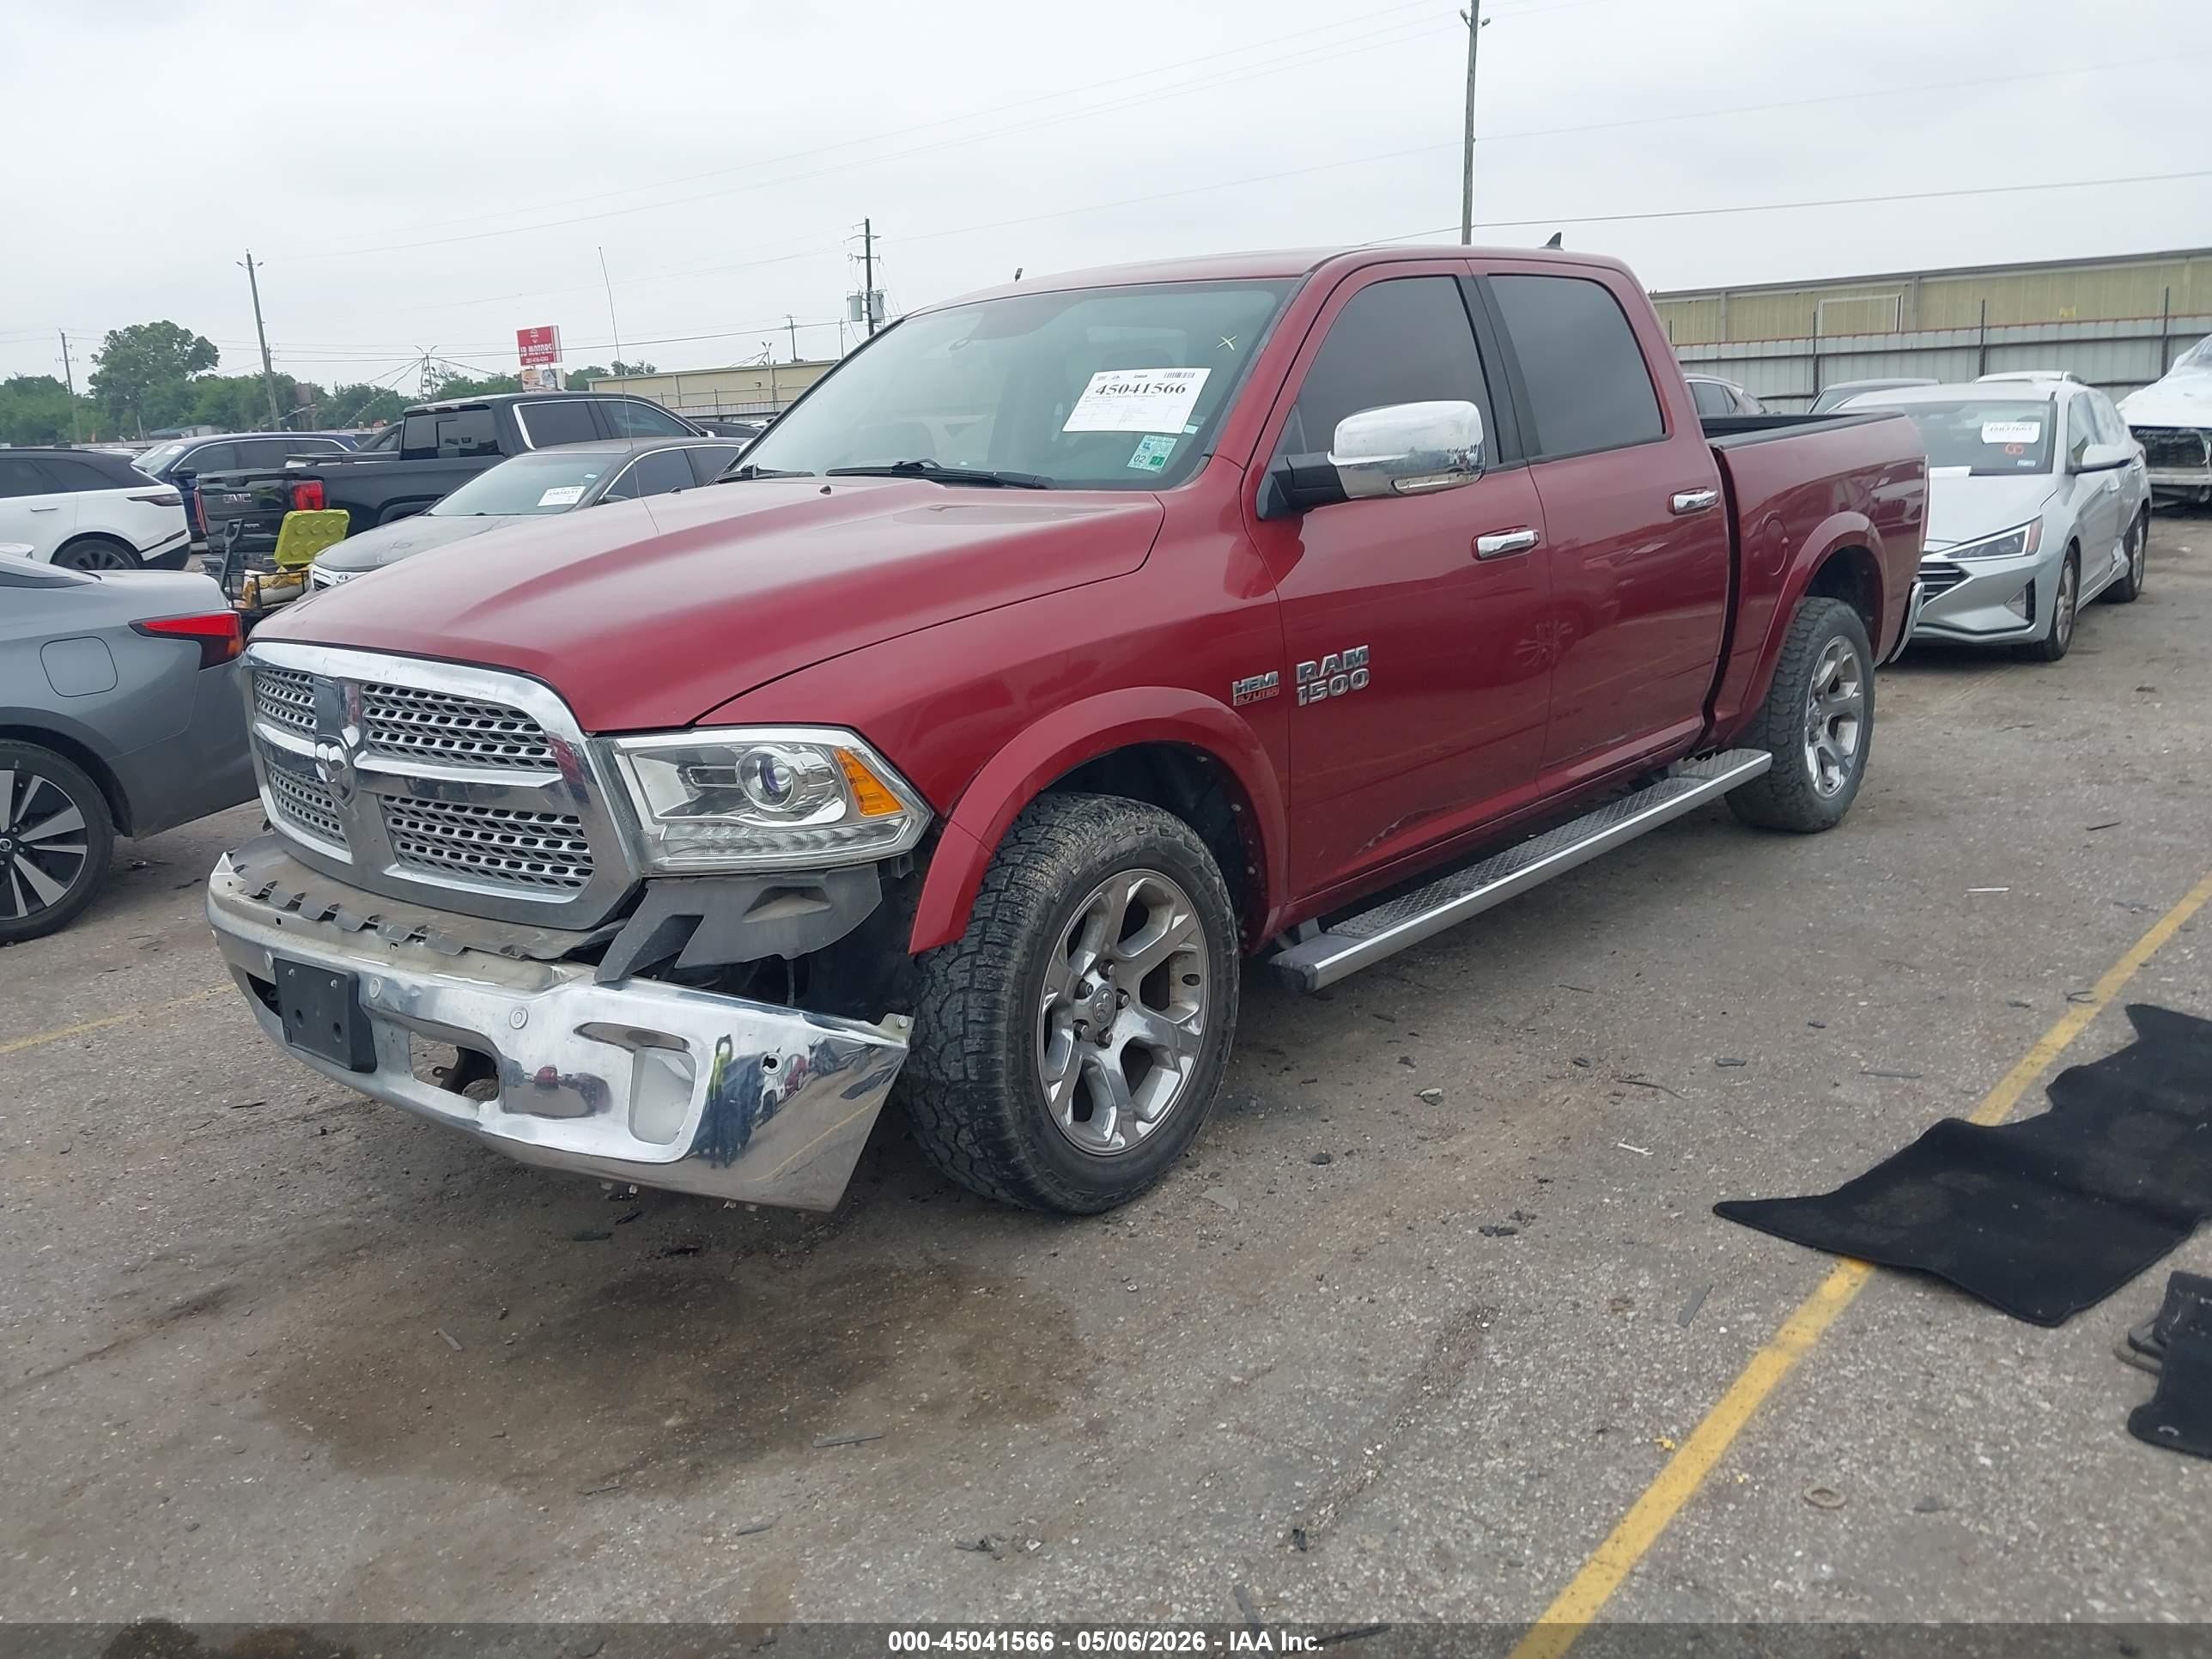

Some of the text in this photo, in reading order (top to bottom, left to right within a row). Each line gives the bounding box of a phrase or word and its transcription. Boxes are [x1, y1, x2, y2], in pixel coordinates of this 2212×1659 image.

[1095, 381, 1187, 395] 45041566
[1133, 454, 1165, 466] 02 27
[222, 493, 252, 504] GMC
[1295, 644, 1370, 684] RAM
[1232, 671, 1279, 696] HEMI
[1296, 667, 1370, 707] 1500
